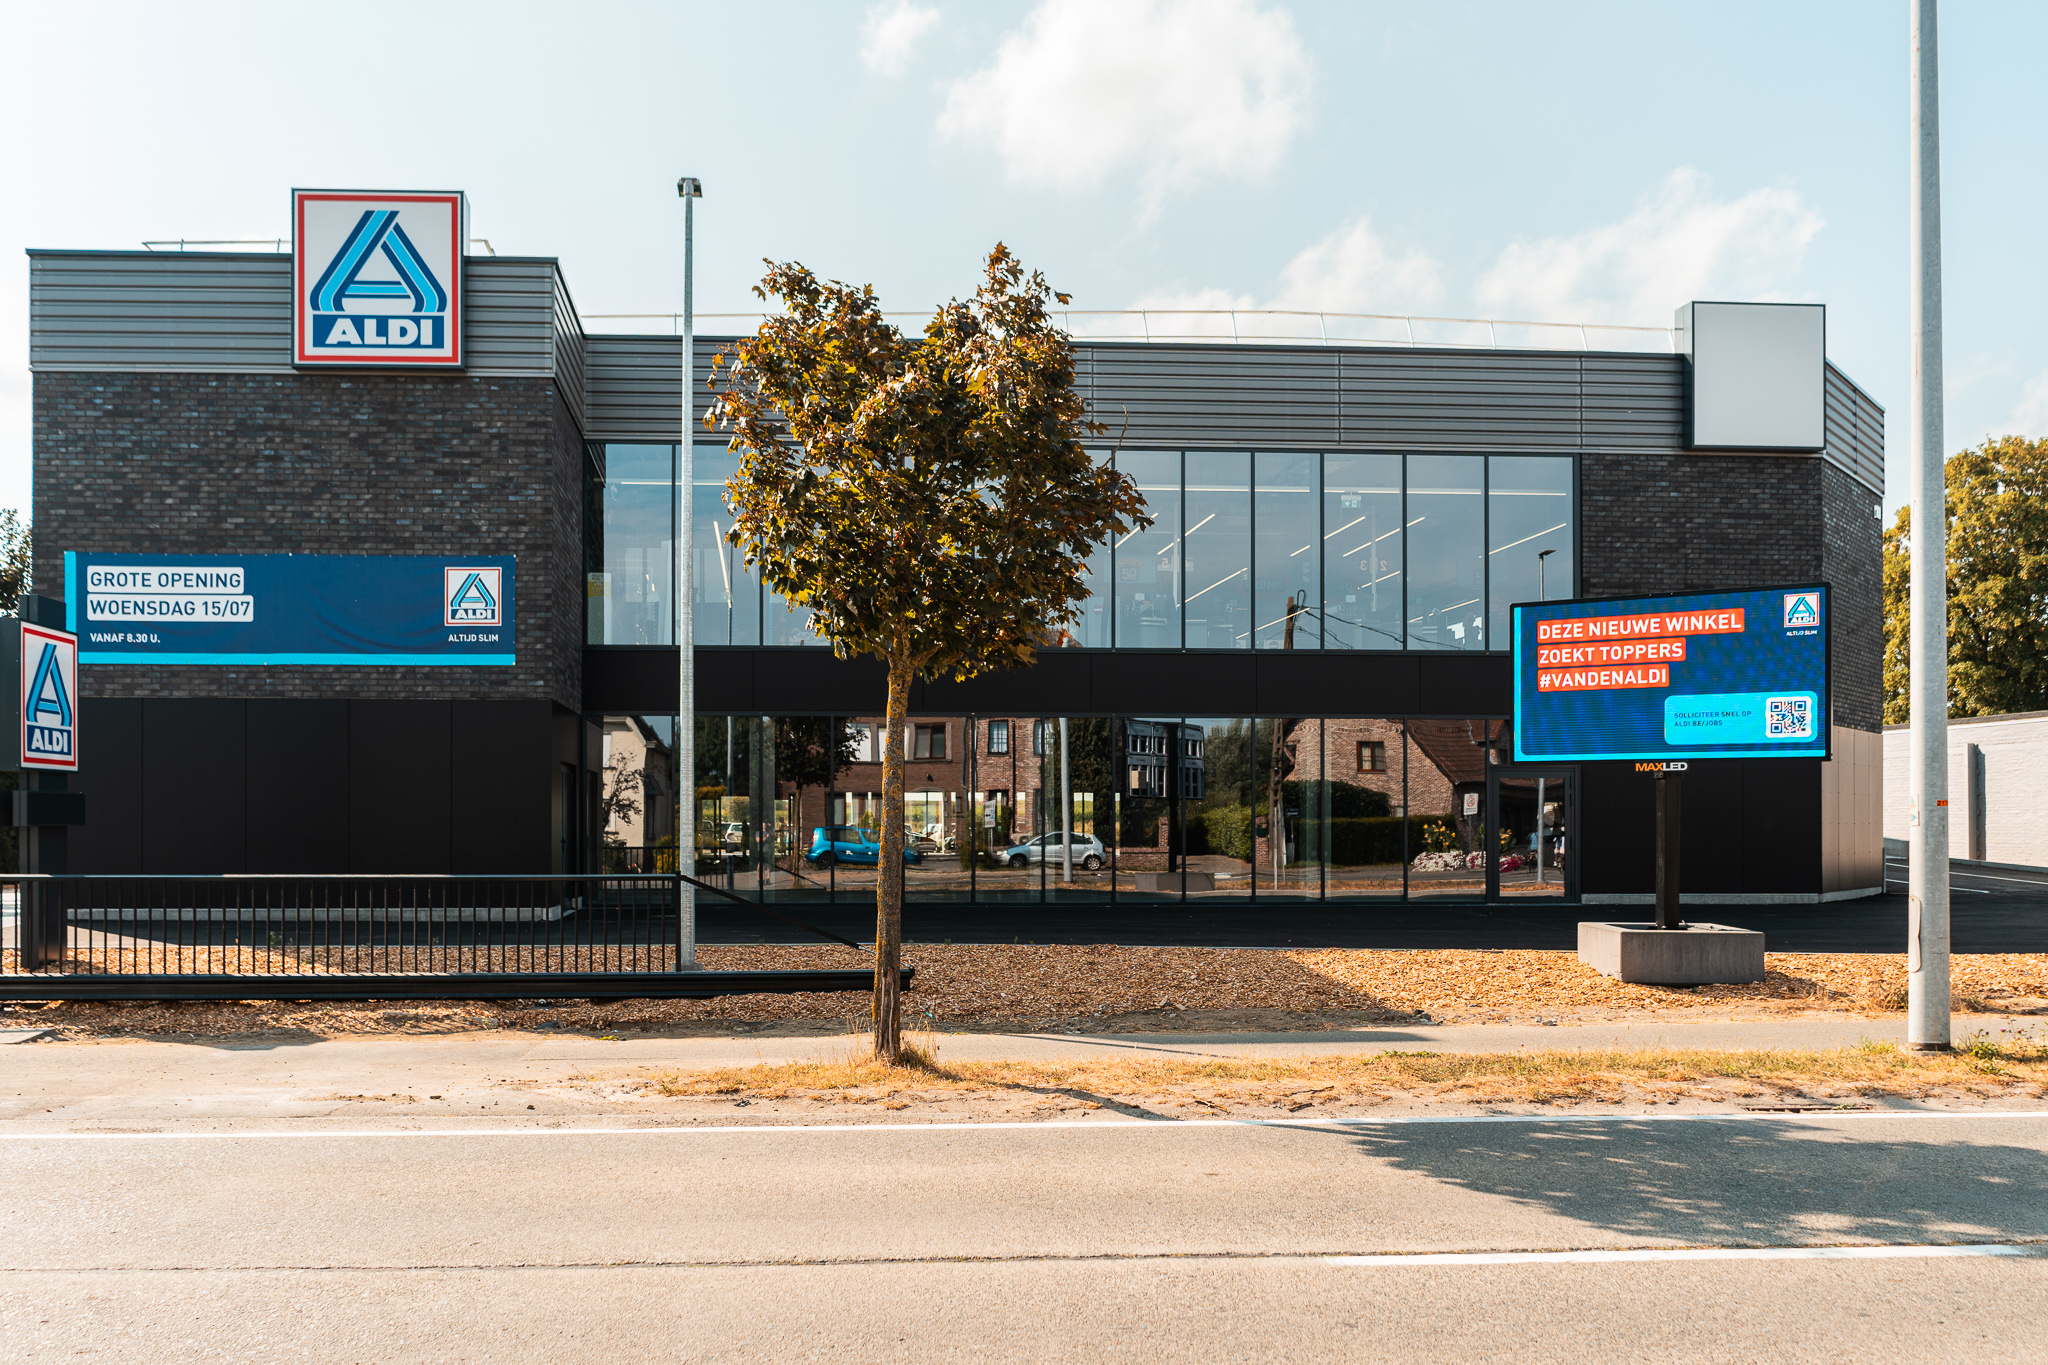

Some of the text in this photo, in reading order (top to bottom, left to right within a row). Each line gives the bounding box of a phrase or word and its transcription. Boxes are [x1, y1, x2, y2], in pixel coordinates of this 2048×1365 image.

[325, 318, 433, 346] ALDI
[90, 572, 242, 588] GROTE OPENING
[89, 599, 251, 618] WOENSDAG 15/07
[454, 609, 492, 619] ALDI
[1539, 613, 1742, 640] DEZE NIEUWE WINKEL
[90, 633, 161, 643] VANAF 8.30 U.
[448, 633, 499, 642] ALTIJD SLIM
[1539, 643, 1683, 664] ZOEKT TOPPERS
[1539, 668, 1667, 688] #VANDENALDI
[1674, 719, 1723, 727] ALDI.BE/JOBS
[31, 728, 69, 753] ALDI
[1635, 761, 1688, 772] MAXLED
